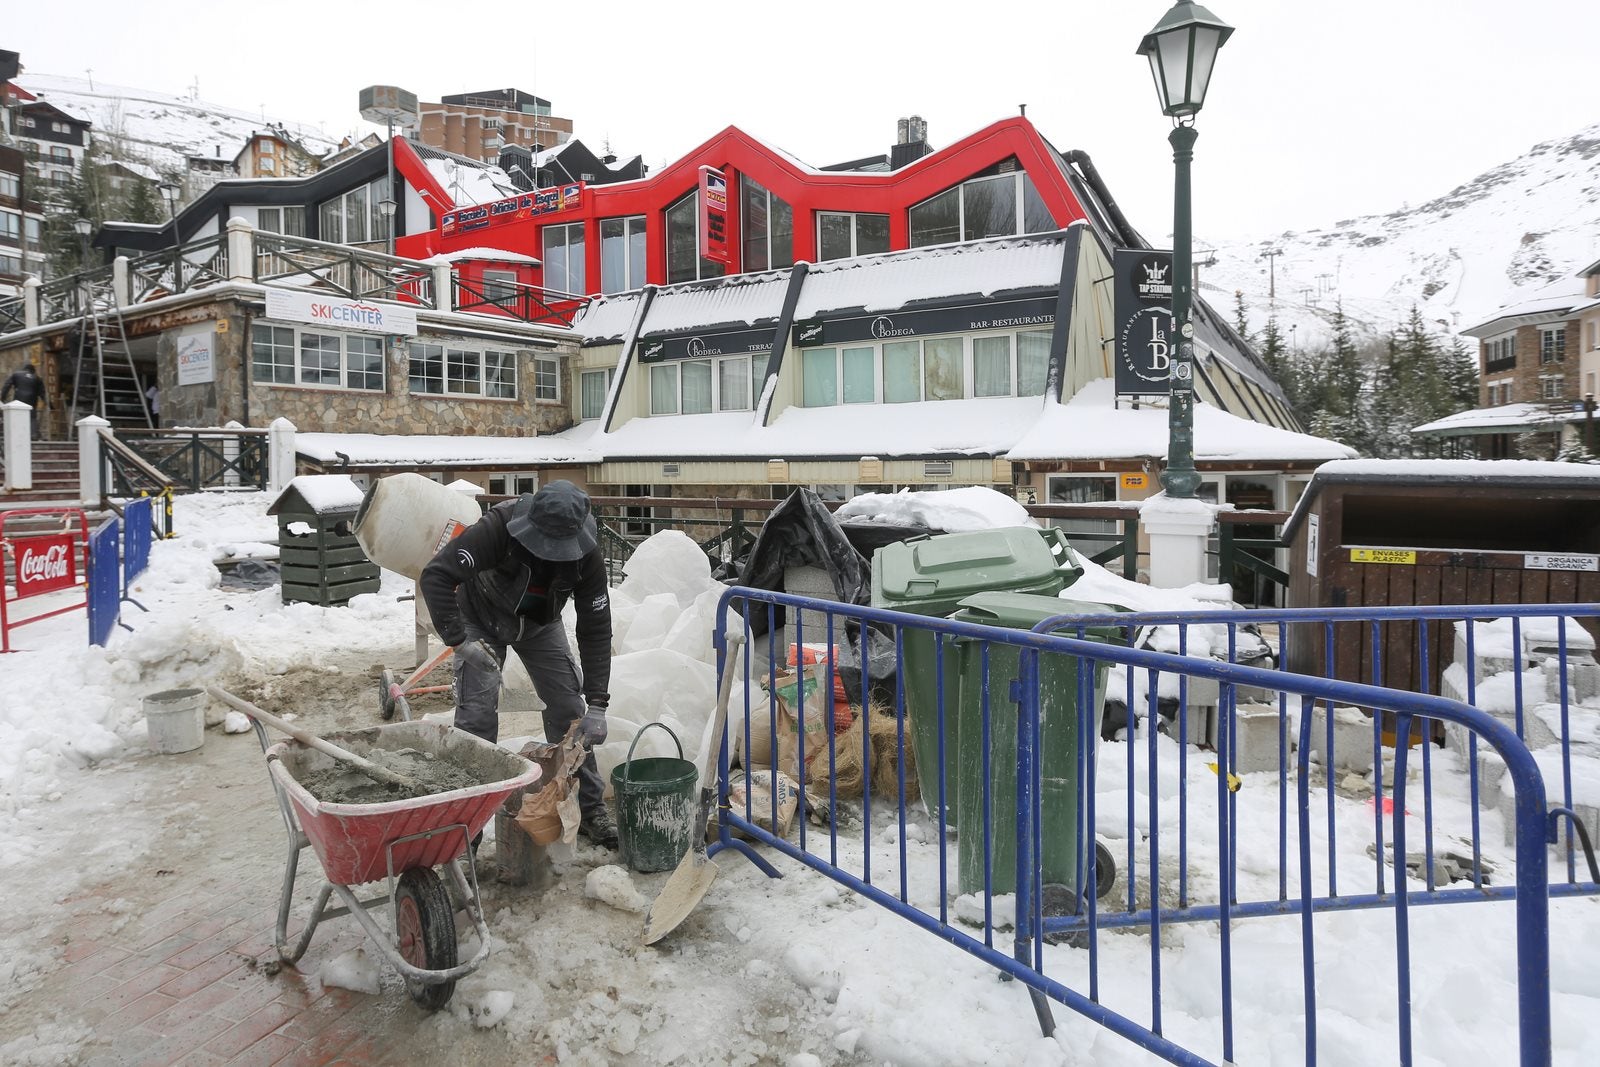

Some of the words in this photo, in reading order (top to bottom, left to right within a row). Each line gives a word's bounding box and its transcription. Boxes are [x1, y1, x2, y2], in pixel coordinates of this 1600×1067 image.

[459, 208, 488, 223] Escuela
[491, 199, 518, 215] Oficial
[521, 196, 532, 209] de
[1139, 284, 1149, 293] TAP
[1150, 284, 1172, 294] STATION
[311, 303, 382, 325] SKICENTER
[992, 315, 1055, 326] RESTAURANTE
[1122, 311, 1142, 372] RESTAURANTE
[1149, 316, 1167, 344] La
[748, 343, 774, 351] TERRAZ
[1147, 342, 1170, 371] B
